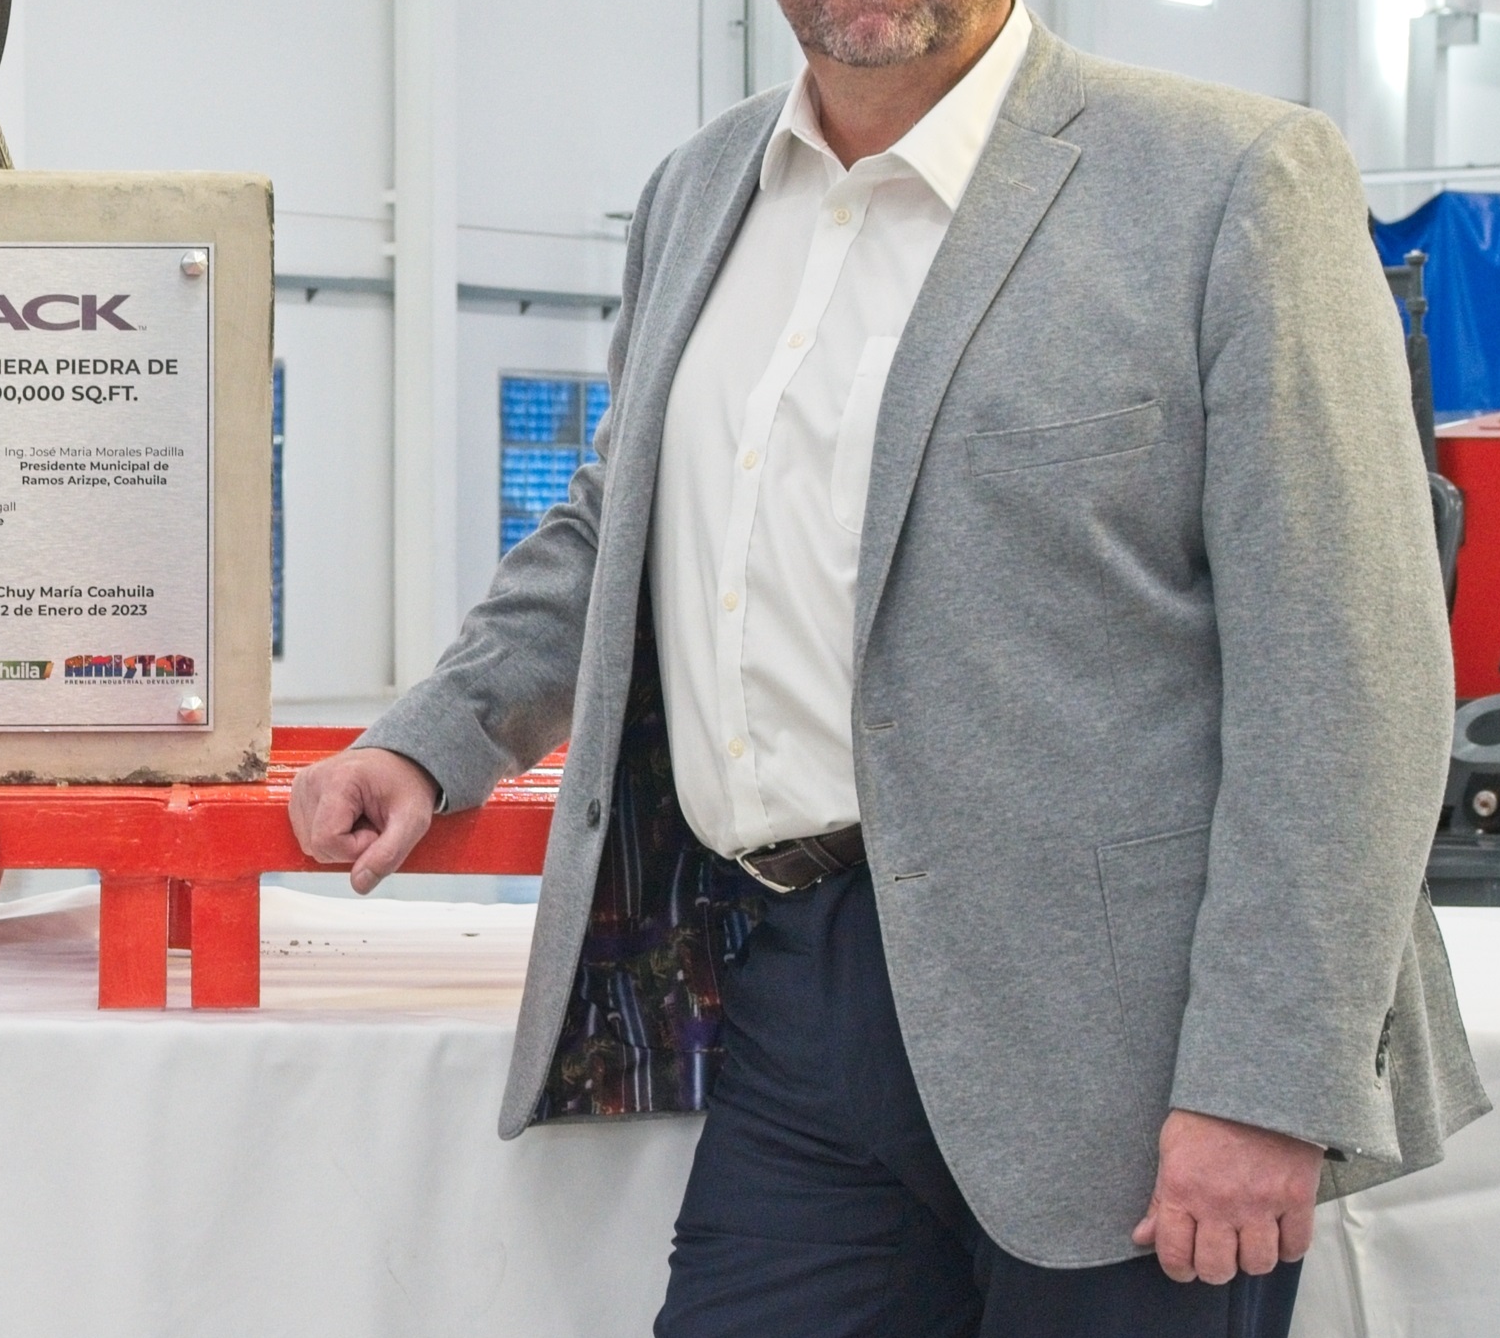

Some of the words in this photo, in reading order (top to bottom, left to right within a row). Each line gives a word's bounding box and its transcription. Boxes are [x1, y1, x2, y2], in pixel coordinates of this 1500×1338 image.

[57, 359, 141, 374] PIEDRA
[149, 359, 178, 374] DE
[72, 386, 138, 404] SQ.FT.
[4, 447, 28, 460] Ing.
[29, 447, 57, 457] José
[59, 446, 92, 457] Maria
[95, 447, 142, 457] Morales
[145, 446, 184, 457] Padilla
[19, 460, 87, 471] Presidente
[90, 460, 150, 473] Municipal
[153, 460, 170, 471] de
[21, 475, 65, 486] Ramos
[67, 474, 111, 488] Arizpe,
[113, 474, 167, 486] Coahuila
[40, 585, 83, 598] María
[87, 584, 155, 598] Coahuila
[13, 603, 34, 617] de
[38, 604, 84, 616] Enero
[87, 603, 108, 616] de
[111, 604, 148, 616] 2023
[64, 655, 194, 678] AMISTAD
